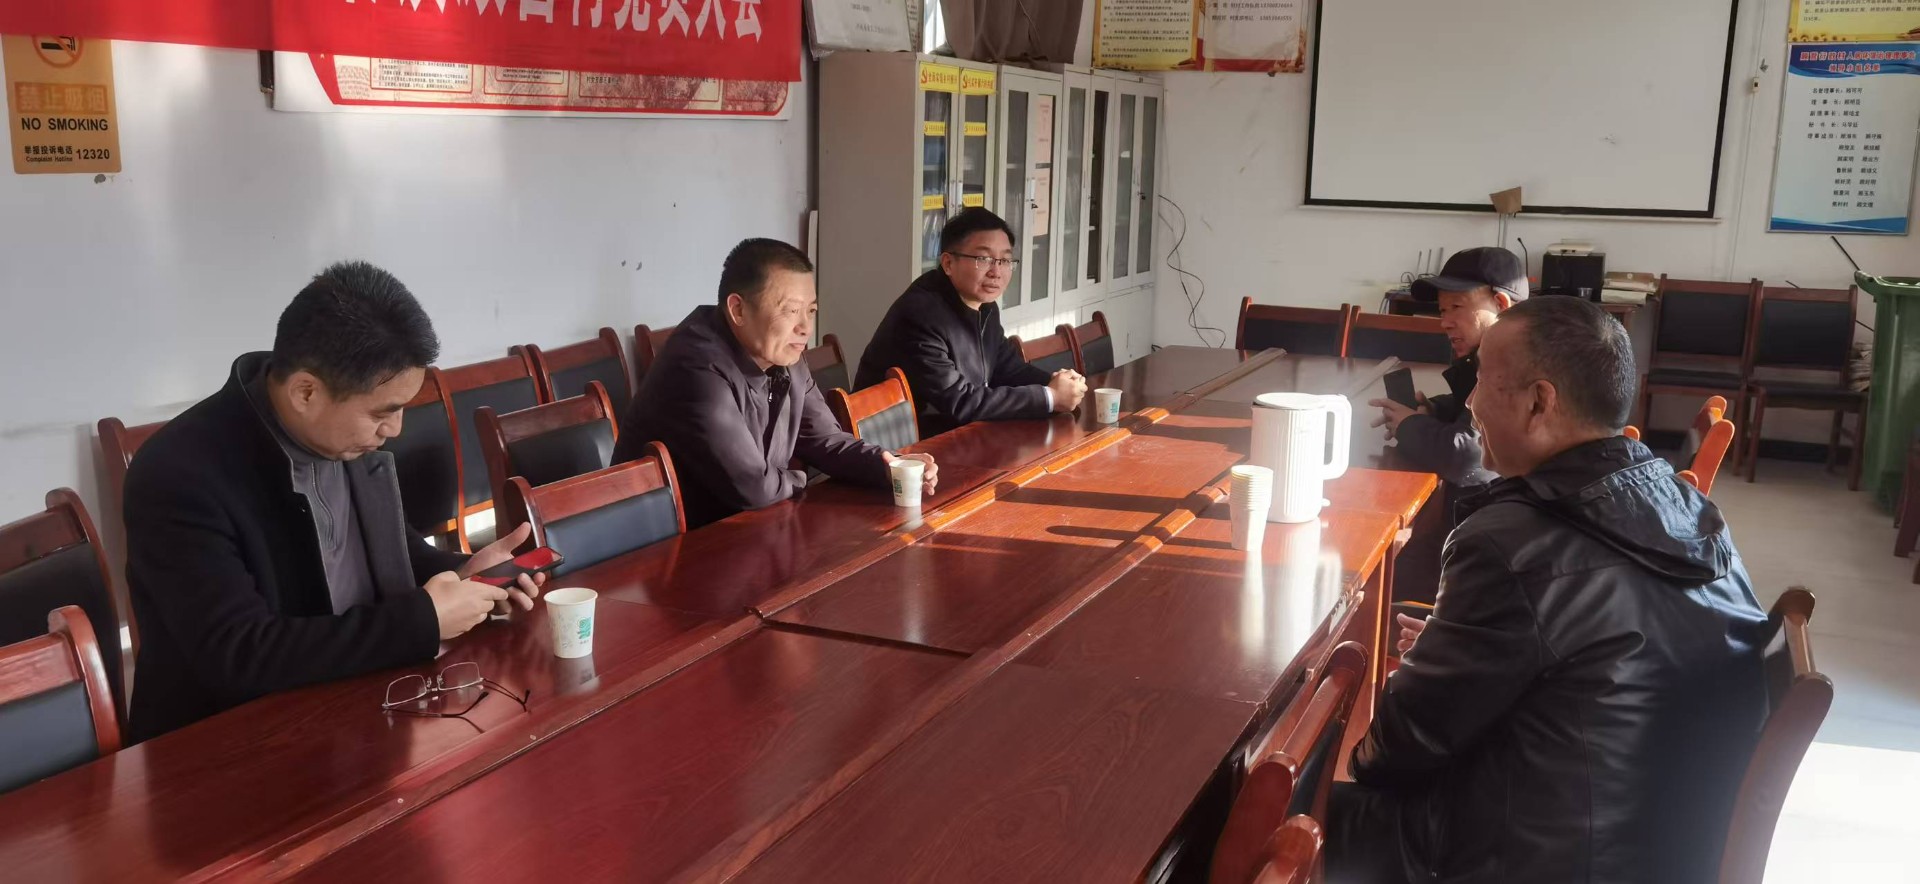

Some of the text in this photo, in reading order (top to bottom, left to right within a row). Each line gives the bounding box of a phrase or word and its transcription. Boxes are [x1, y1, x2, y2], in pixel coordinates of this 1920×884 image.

[18, 85, 105, 112] 禁止吸烟
[21, 118, 108, 131] NO SMOKING
[24, 145, 72, 155] 举报投诉电话
[76, 149, 110, 160] 12320
